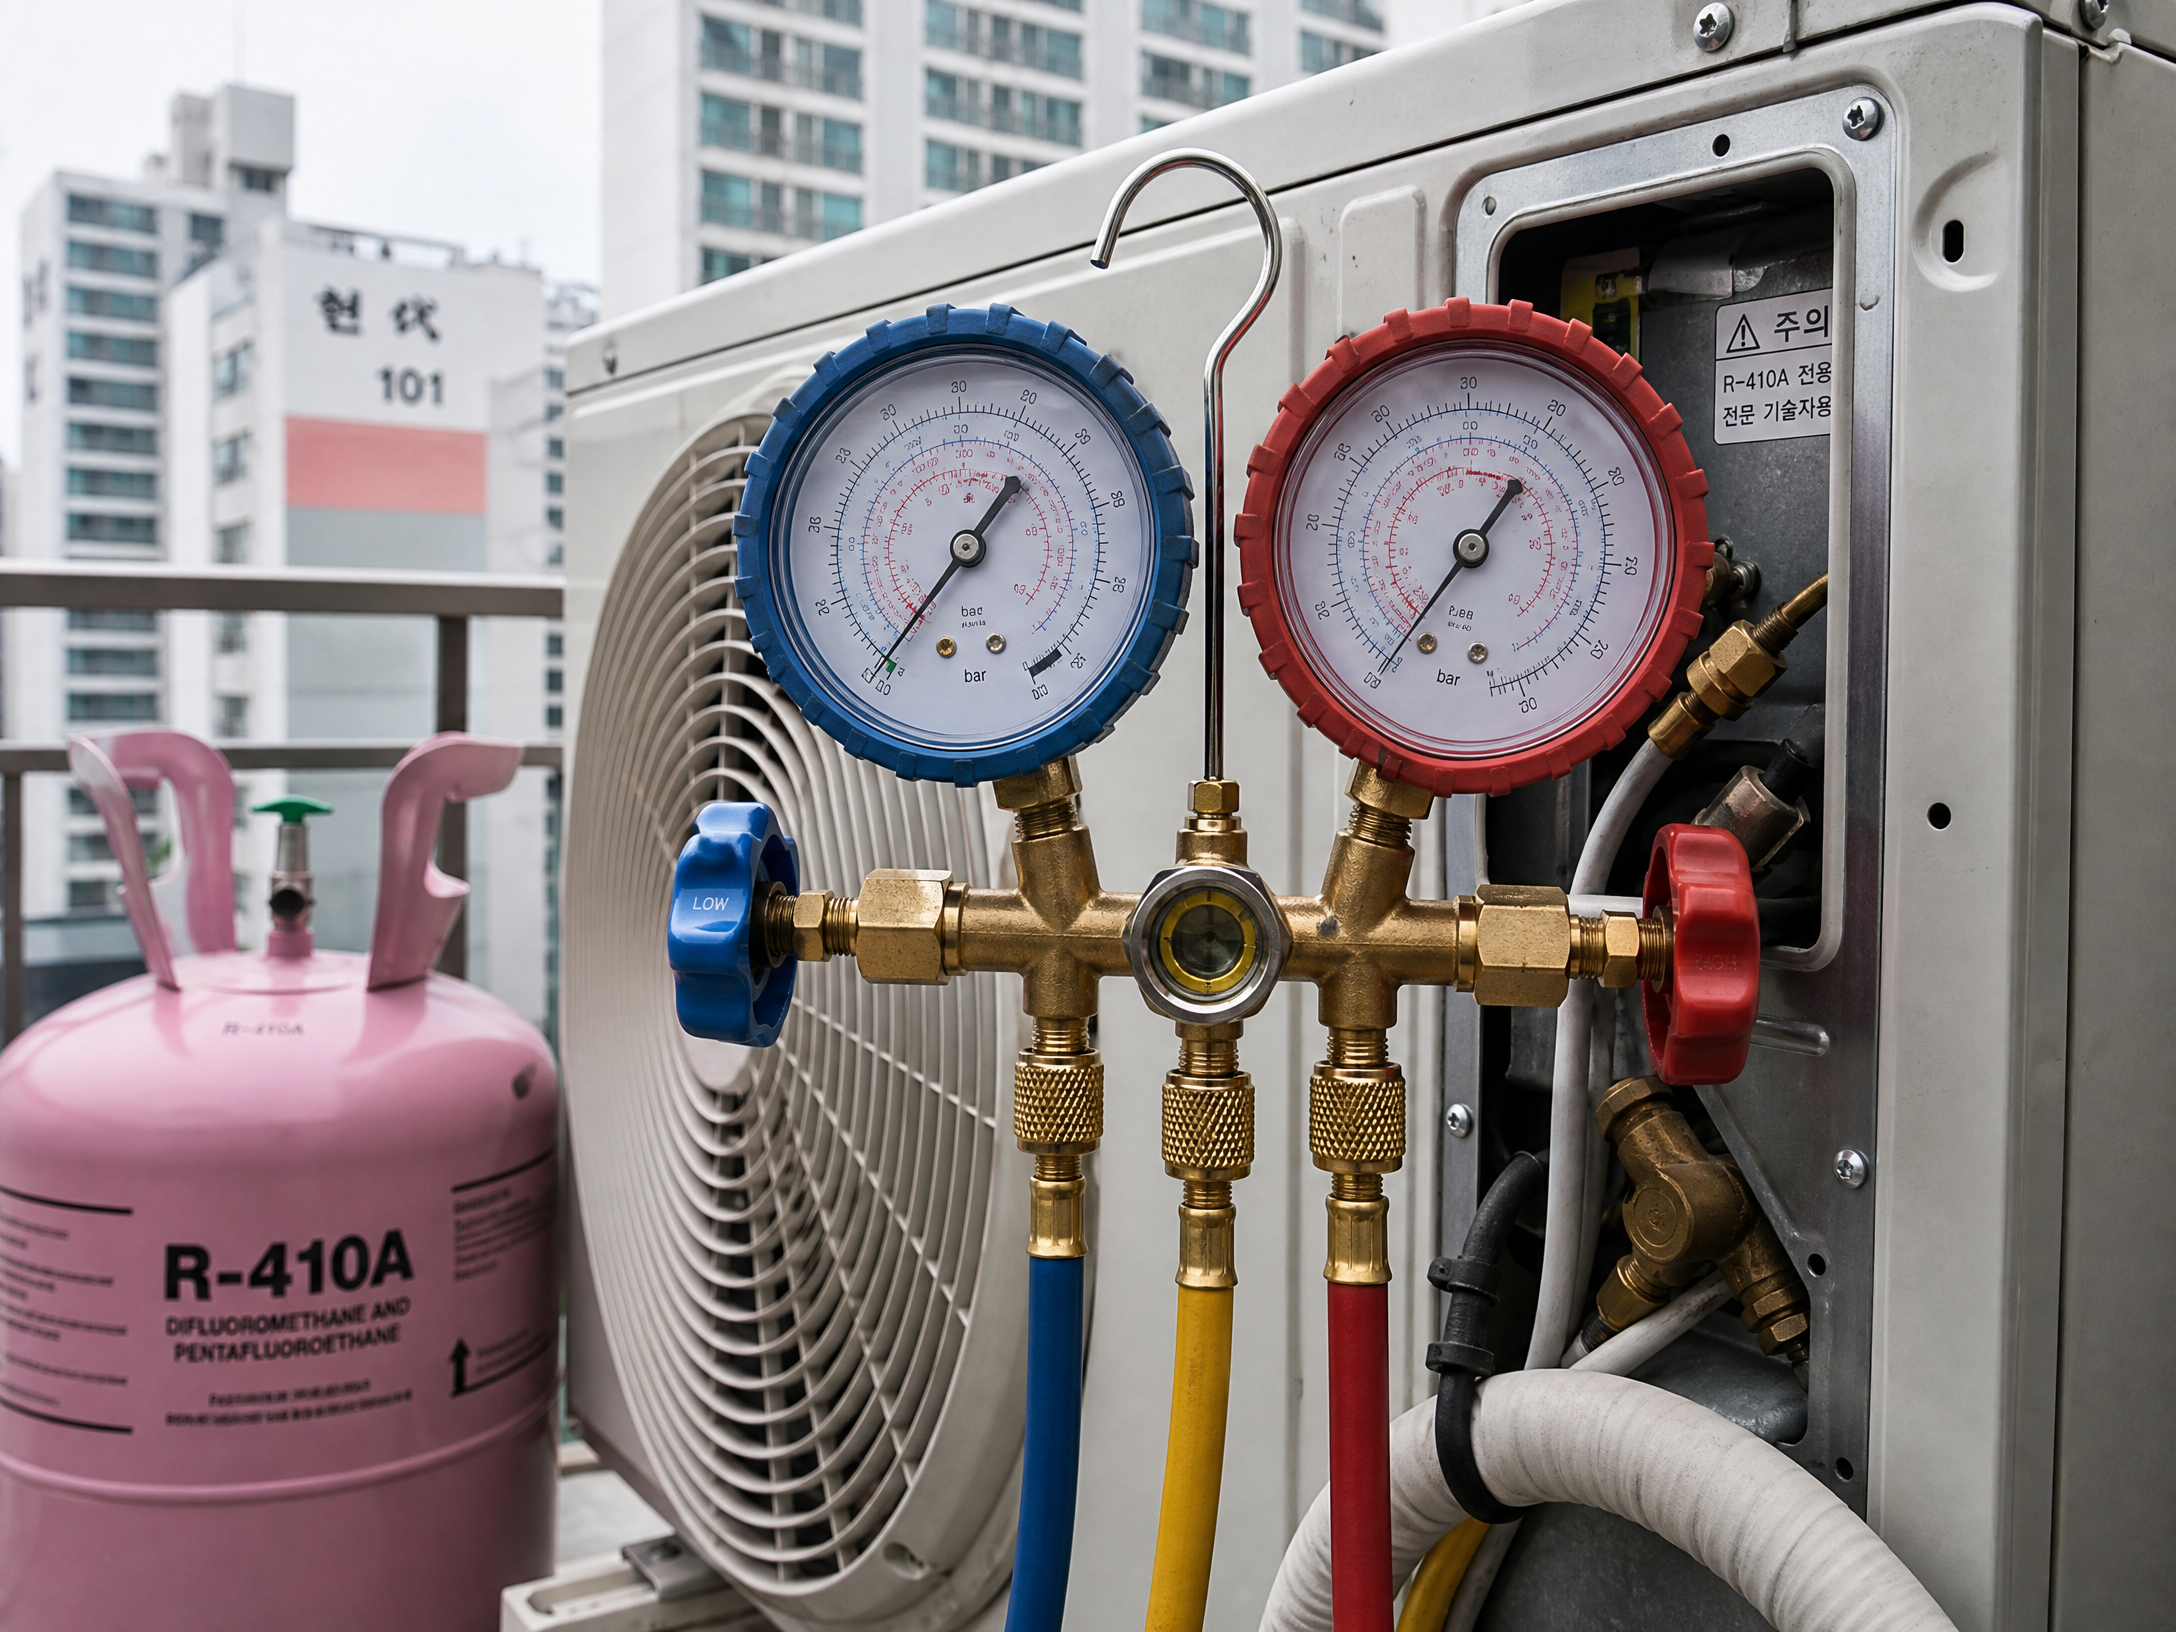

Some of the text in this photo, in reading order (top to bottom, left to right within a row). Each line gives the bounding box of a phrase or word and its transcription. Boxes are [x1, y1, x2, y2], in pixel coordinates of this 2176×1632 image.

[1774, 305, 1829, 343] 주의
[376, 367, 443, 405] 101
[1723, 361, 1832, 393] R-410A 전용
[1723, 404, 1756, 427] 전문
[964, 669, 987, 683] bar
[1436, 668, 1461, 686] bar
[692, 897, 729, 911] LOW
[164, 1229, 414, 1301] R-410A
[165, 1296, 411, 1336] DIFLUOROMETHANE AND
[174, 1322, 401, 1363] PENTAFLUOROETHANE
